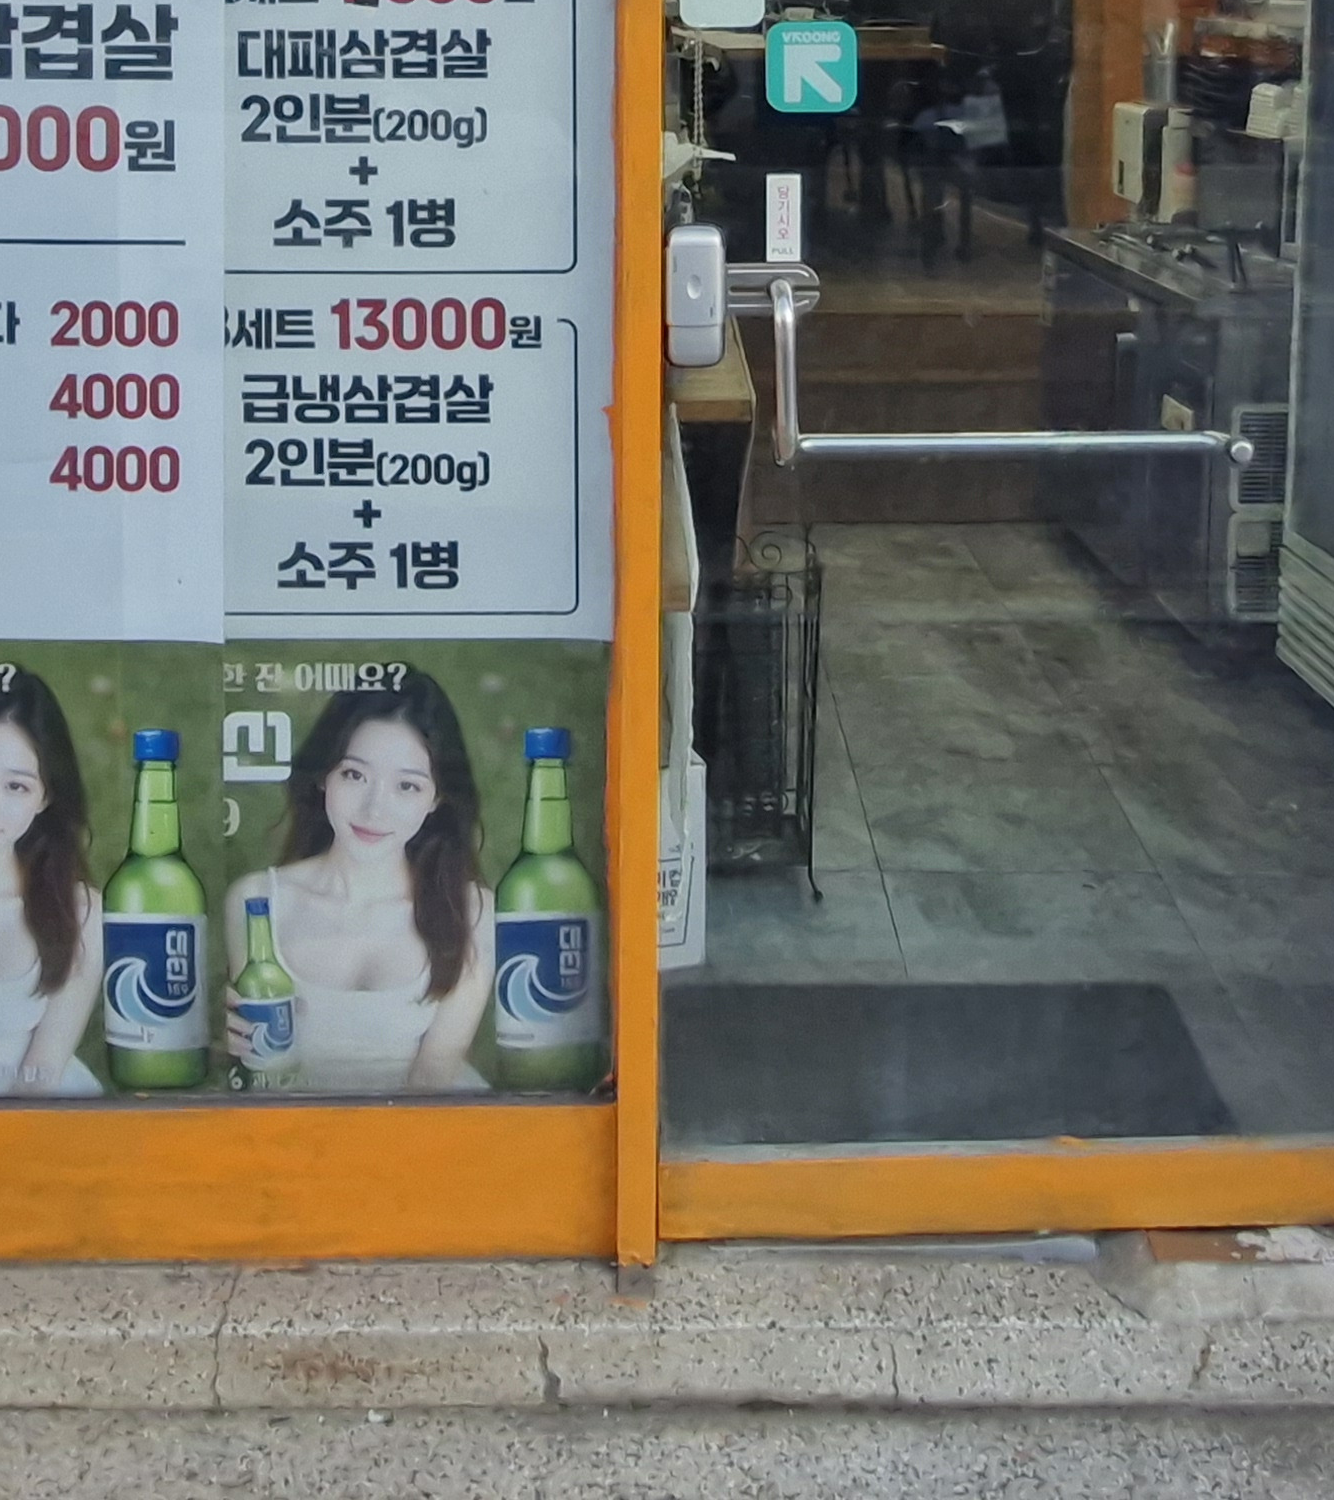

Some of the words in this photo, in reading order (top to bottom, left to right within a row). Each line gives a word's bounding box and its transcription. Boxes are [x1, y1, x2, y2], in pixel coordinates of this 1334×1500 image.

[237, 28, 492, 80] 대패삼겹살
[241, 93, 489, 149] 2인분(200g)
[272, 198, 373, 248] 소주
[386, 198, 457, 249] 1병
[49, 300, 180, 347] 2000
[330, 298, 543, 351] 13000원
[48, 372, 181, 419] 4000
[241, 373, 494, 425] 급냉삼겹살
[48, 445, 181, 493] 4000
[244, 437, 491, 491] 2인분(200g)
[276, 540, 376, 590] 소주
[388, 540, 460, 590] 1병
[294, 661, 407, 693] 어때요?
